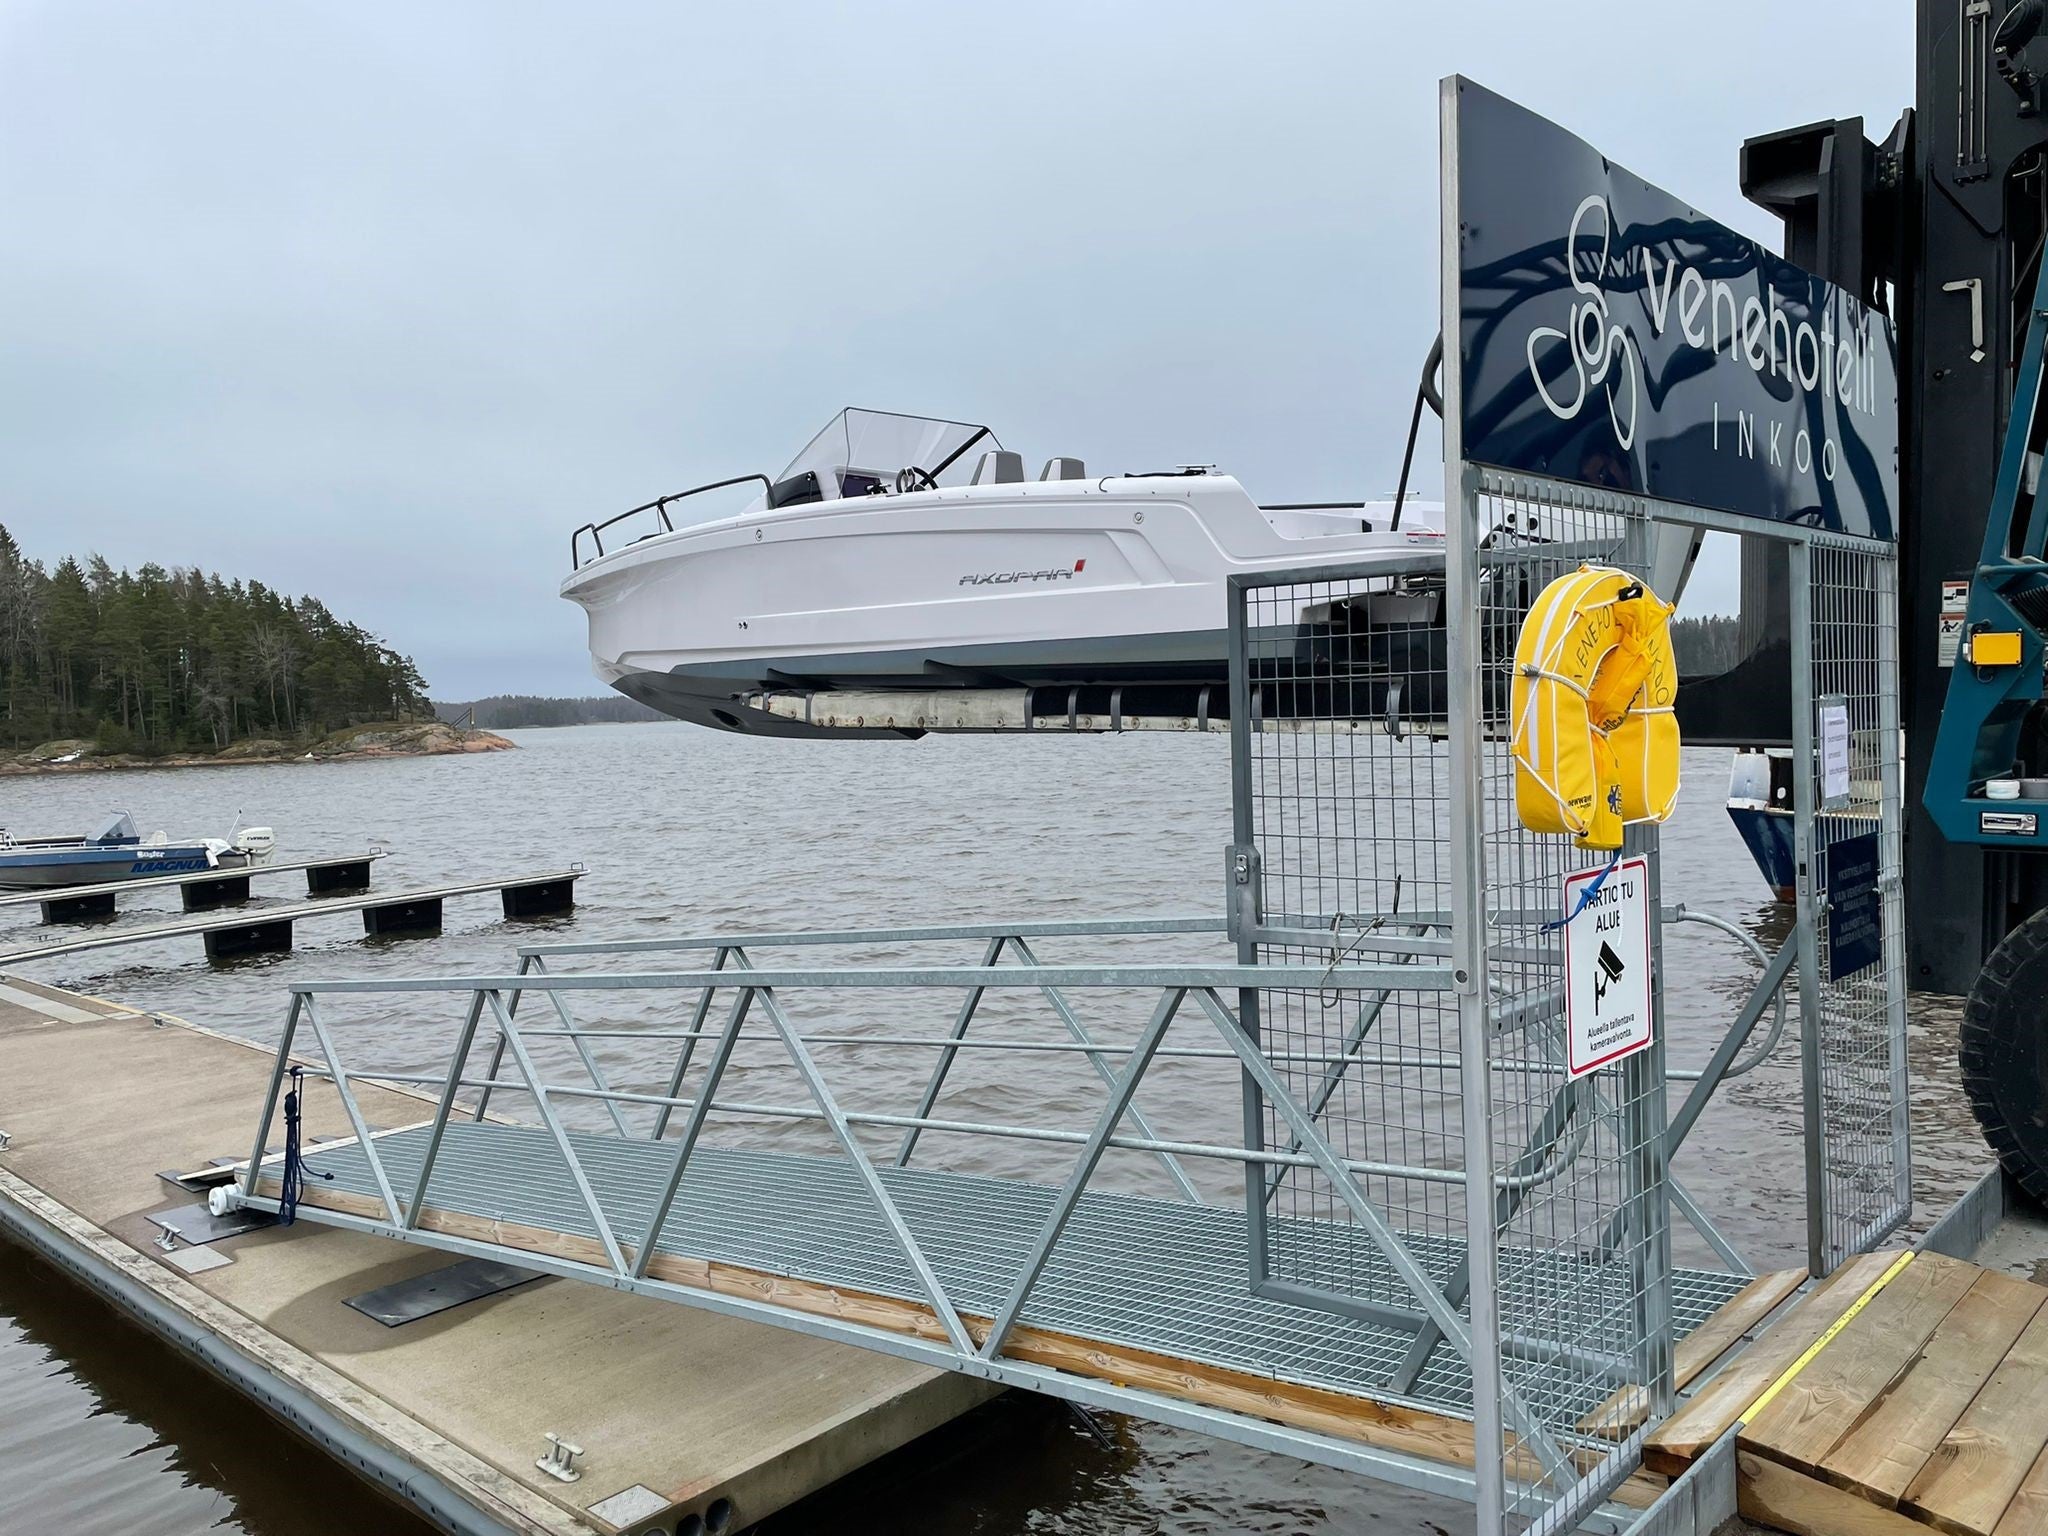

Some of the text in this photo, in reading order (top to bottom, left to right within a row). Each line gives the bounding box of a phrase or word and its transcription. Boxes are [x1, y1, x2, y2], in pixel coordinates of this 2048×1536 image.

[1713, 401, 1838, 481] INKOO
[958, 568, 1074, 586] AXOPAR
[1595, 909, 1621, 934] ALUE
[1587, 1013, 1635, 1039] Alueella tallentava
